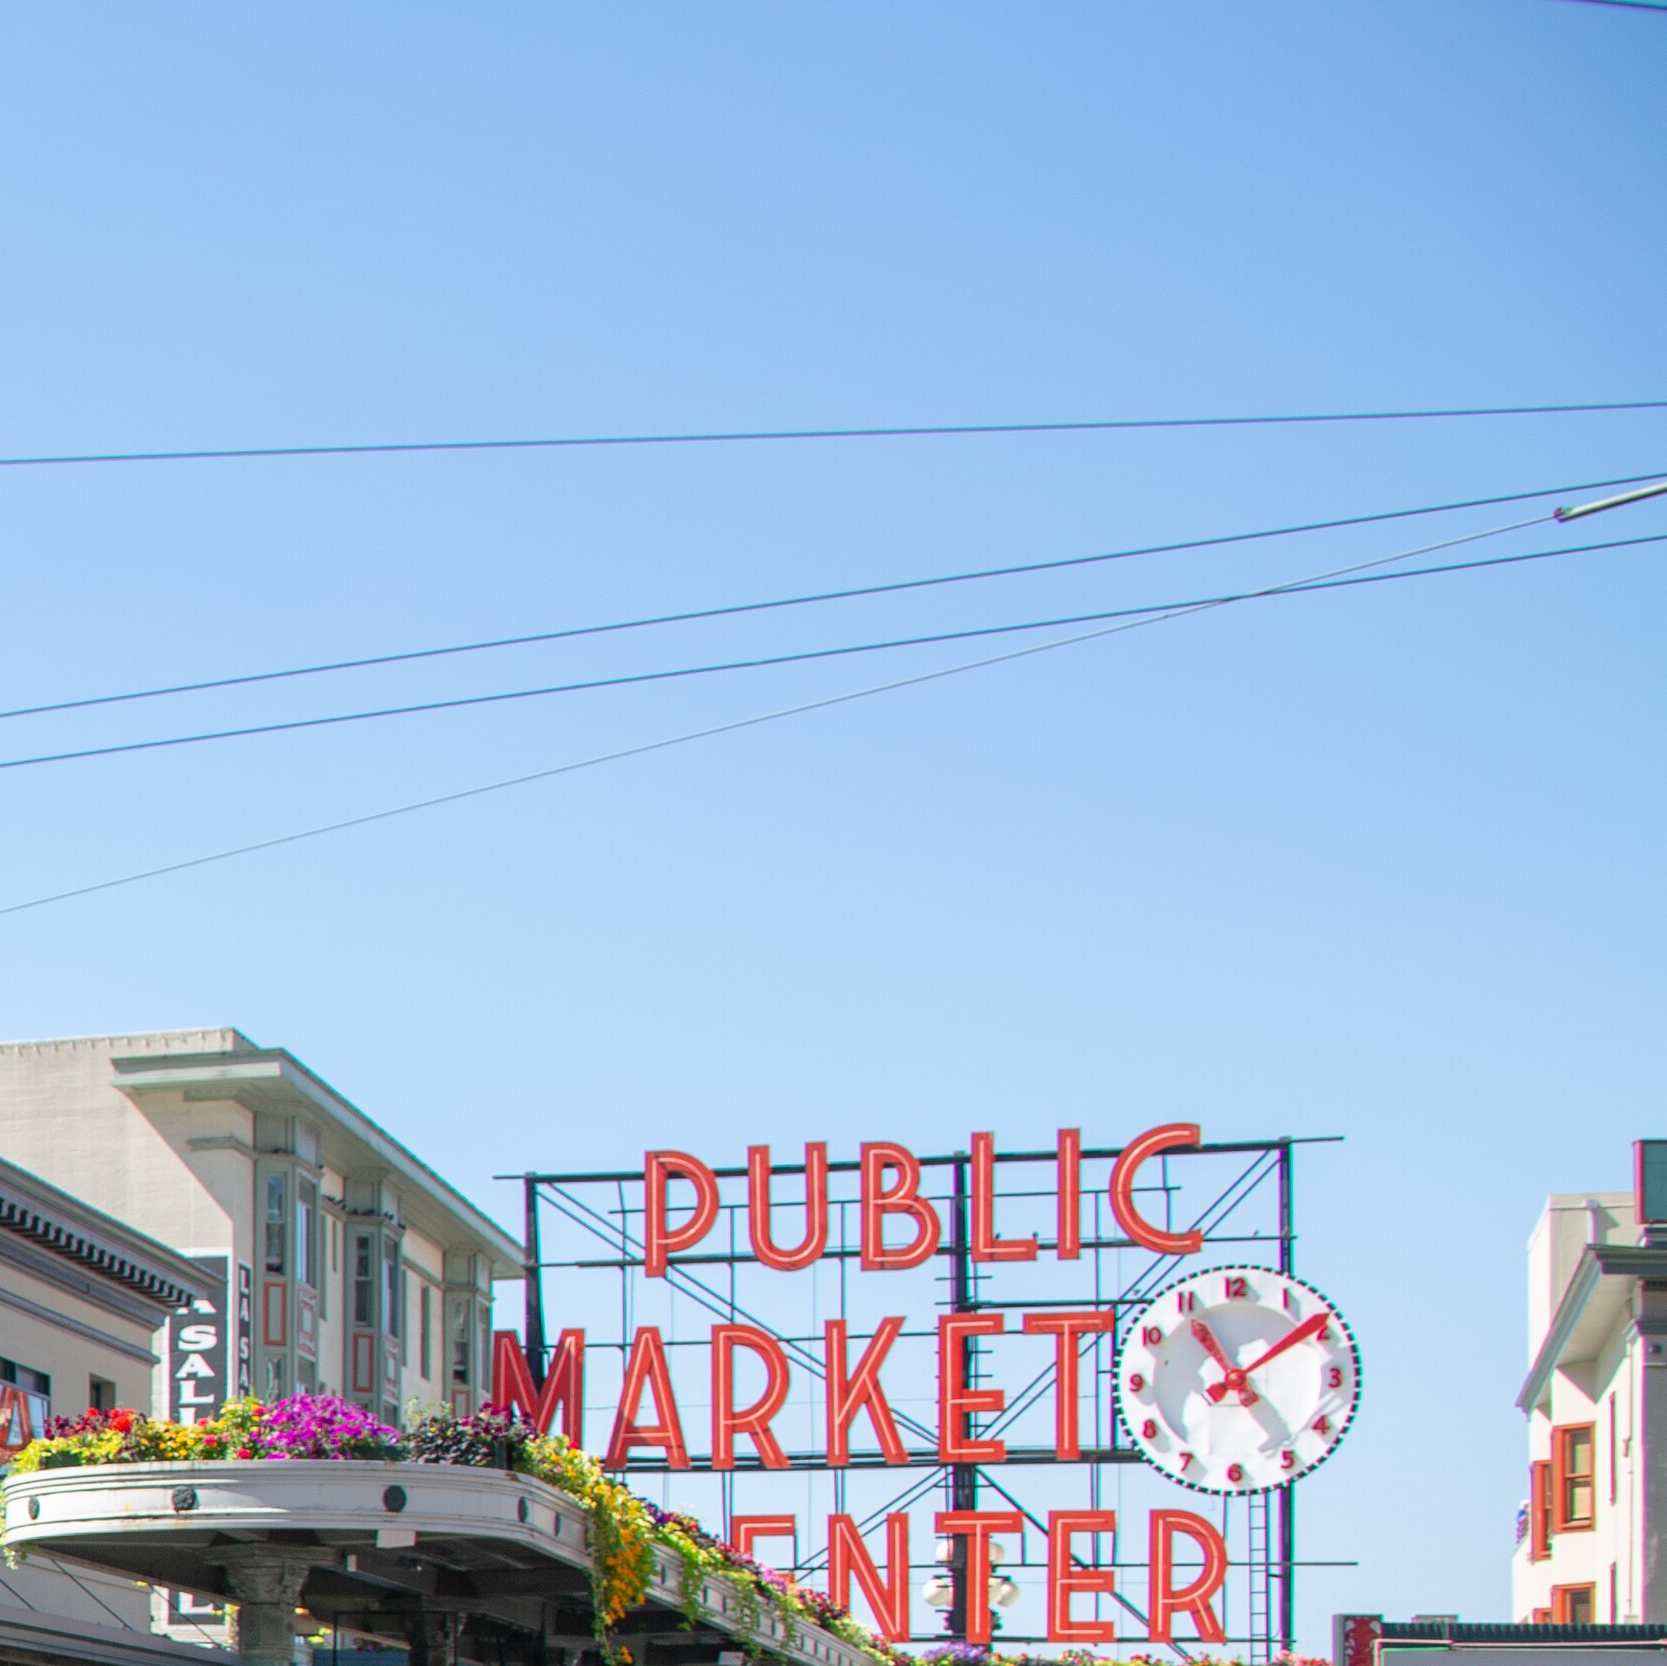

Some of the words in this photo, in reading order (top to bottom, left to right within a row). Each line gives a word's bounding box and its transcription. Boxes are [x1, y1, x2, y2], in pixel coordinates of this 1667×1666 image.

[645, 1123, 1202, 1277] PUBLIC
[1224, 1277, 1248, 1299] 12
[1177, 1291, 1194, 1313] 11
[1142, 1326, 1162, 1347] 10
[1129, 1374, 1144, 1393] 9
[1328, 1367, 1342, 1389] 3
[491, 1310, 1115, 1470] MARKET
[1142, 1419, 1158, 1439] 8
[1312, 1414, 1330, 1436] 4
[1178, 1453, 1194, 1472] 7
[1281, 1450, 1295, 1469] 5
[1227, 1463, 1243, 1482] 6
